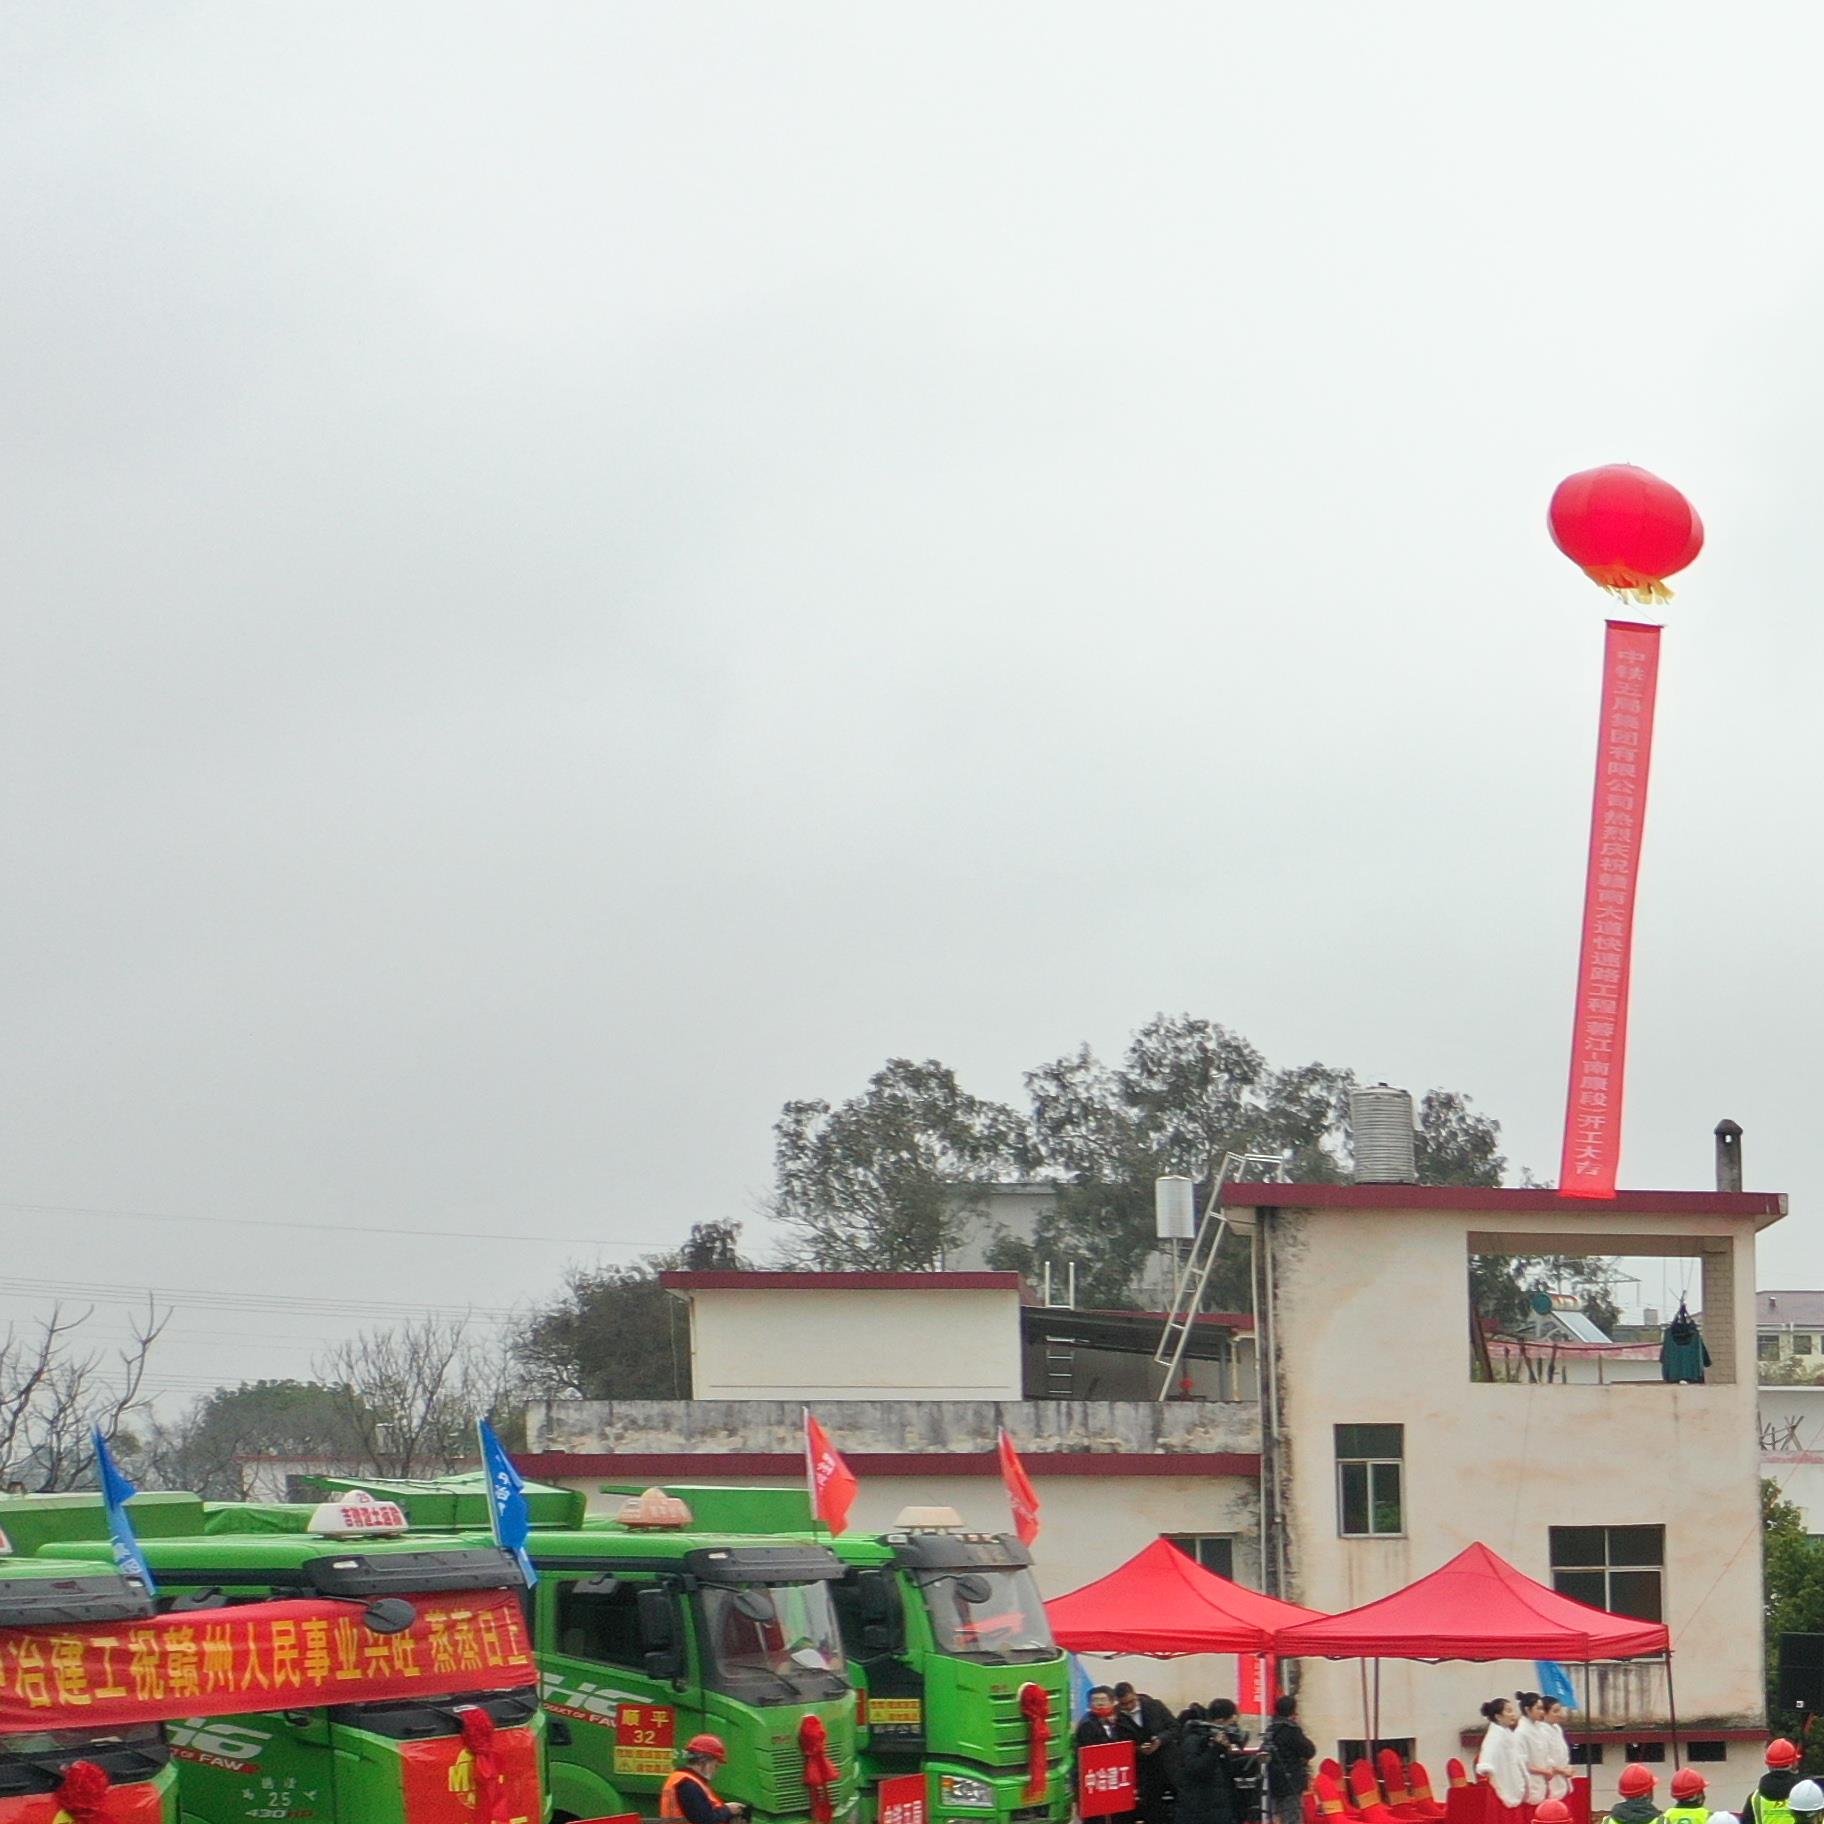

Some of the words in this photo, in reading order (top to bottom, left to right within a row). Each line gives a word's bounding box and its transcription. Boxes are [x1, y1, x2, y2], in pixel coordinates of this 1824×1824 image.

[0, 1617, 422, 1708] 冶建工祝赣州人民事业兴旺
[424, 1606, 529, 1673] 蒸蒸日上
[634, 1730, 656, 1744] 32
[199, 1754, 244, 1771] FAW
[269, 1792, 292, 1807] 25
